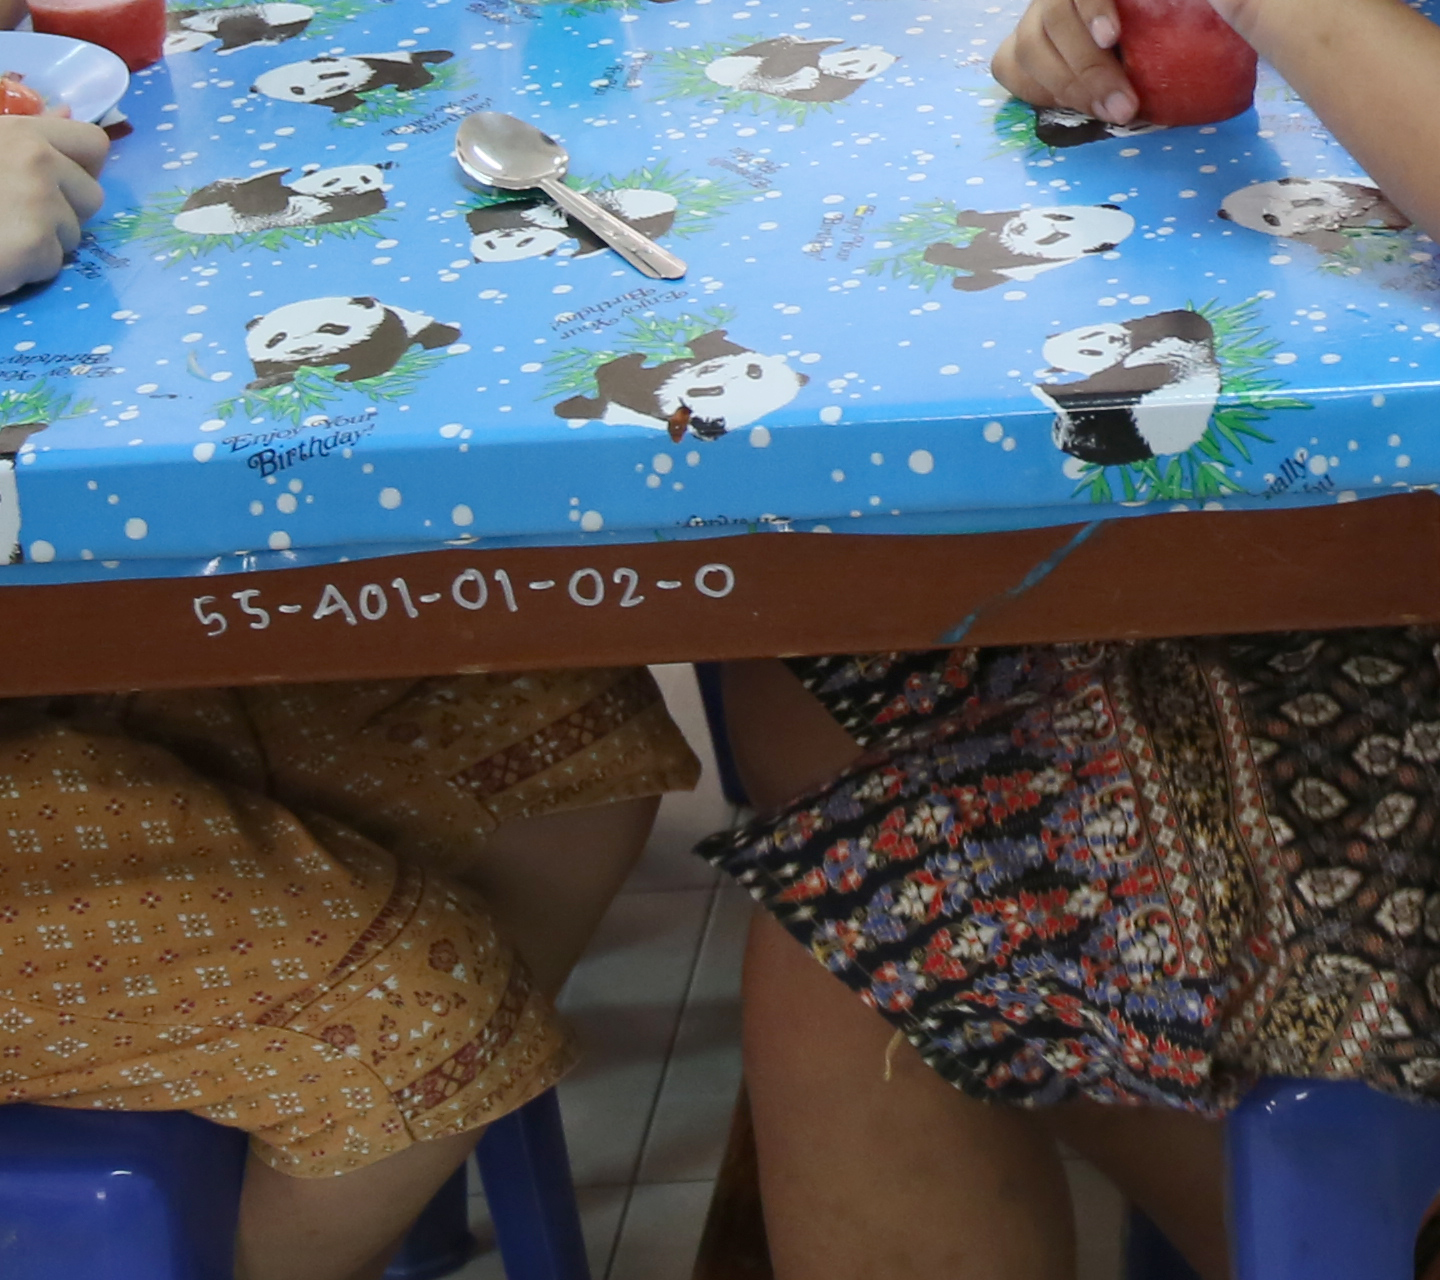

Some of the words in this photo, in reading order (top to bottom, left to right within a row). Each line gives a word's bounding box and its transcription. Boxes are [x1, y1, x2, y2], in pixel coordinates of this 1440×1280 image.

[221, 425, 307, 453] Enjoy
[310, 411, 379, 429] Your
[246, 423, 376, 479] Birthday!
